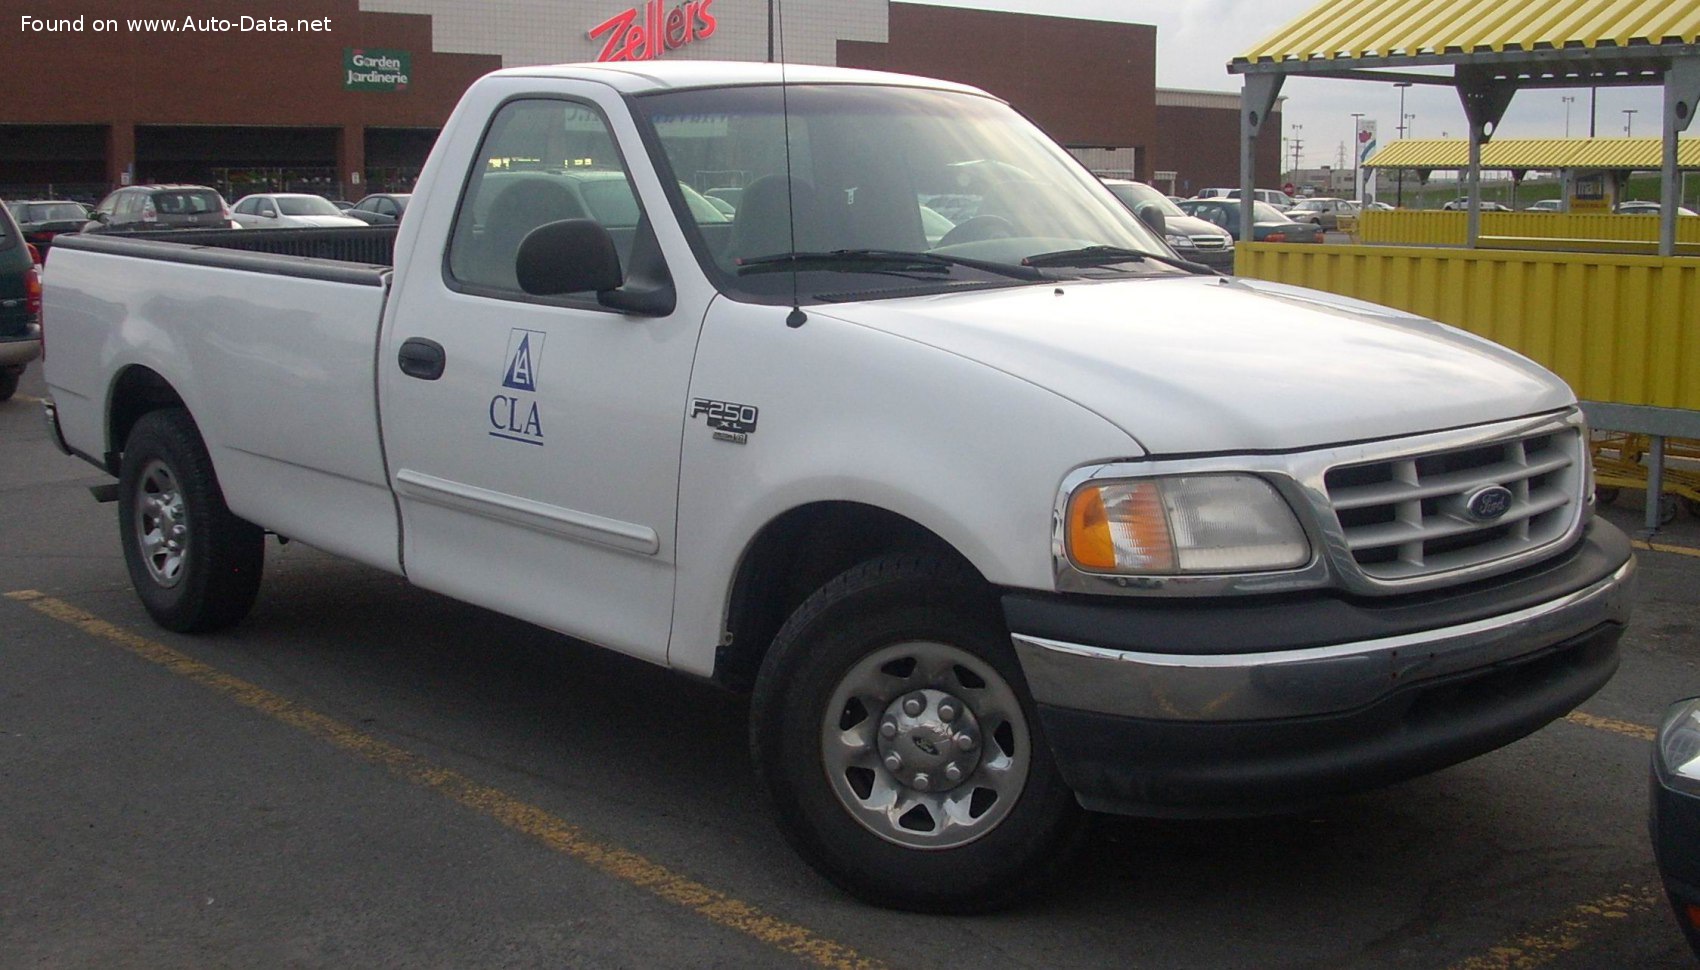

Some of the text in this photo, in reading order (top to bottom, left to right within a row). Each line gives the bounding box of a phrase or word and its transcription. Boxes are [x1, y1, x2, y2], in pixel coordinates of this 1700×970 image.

[589, 0, 717, 62] Zellers
[353, 54, 400, 68] Garden
[346, 70, 408, 84] Jardinerie
[489, 394, 544, 437] CLA
[720, 421, 742, 429] XL
[1480, 493, 1505, 514] Ford
